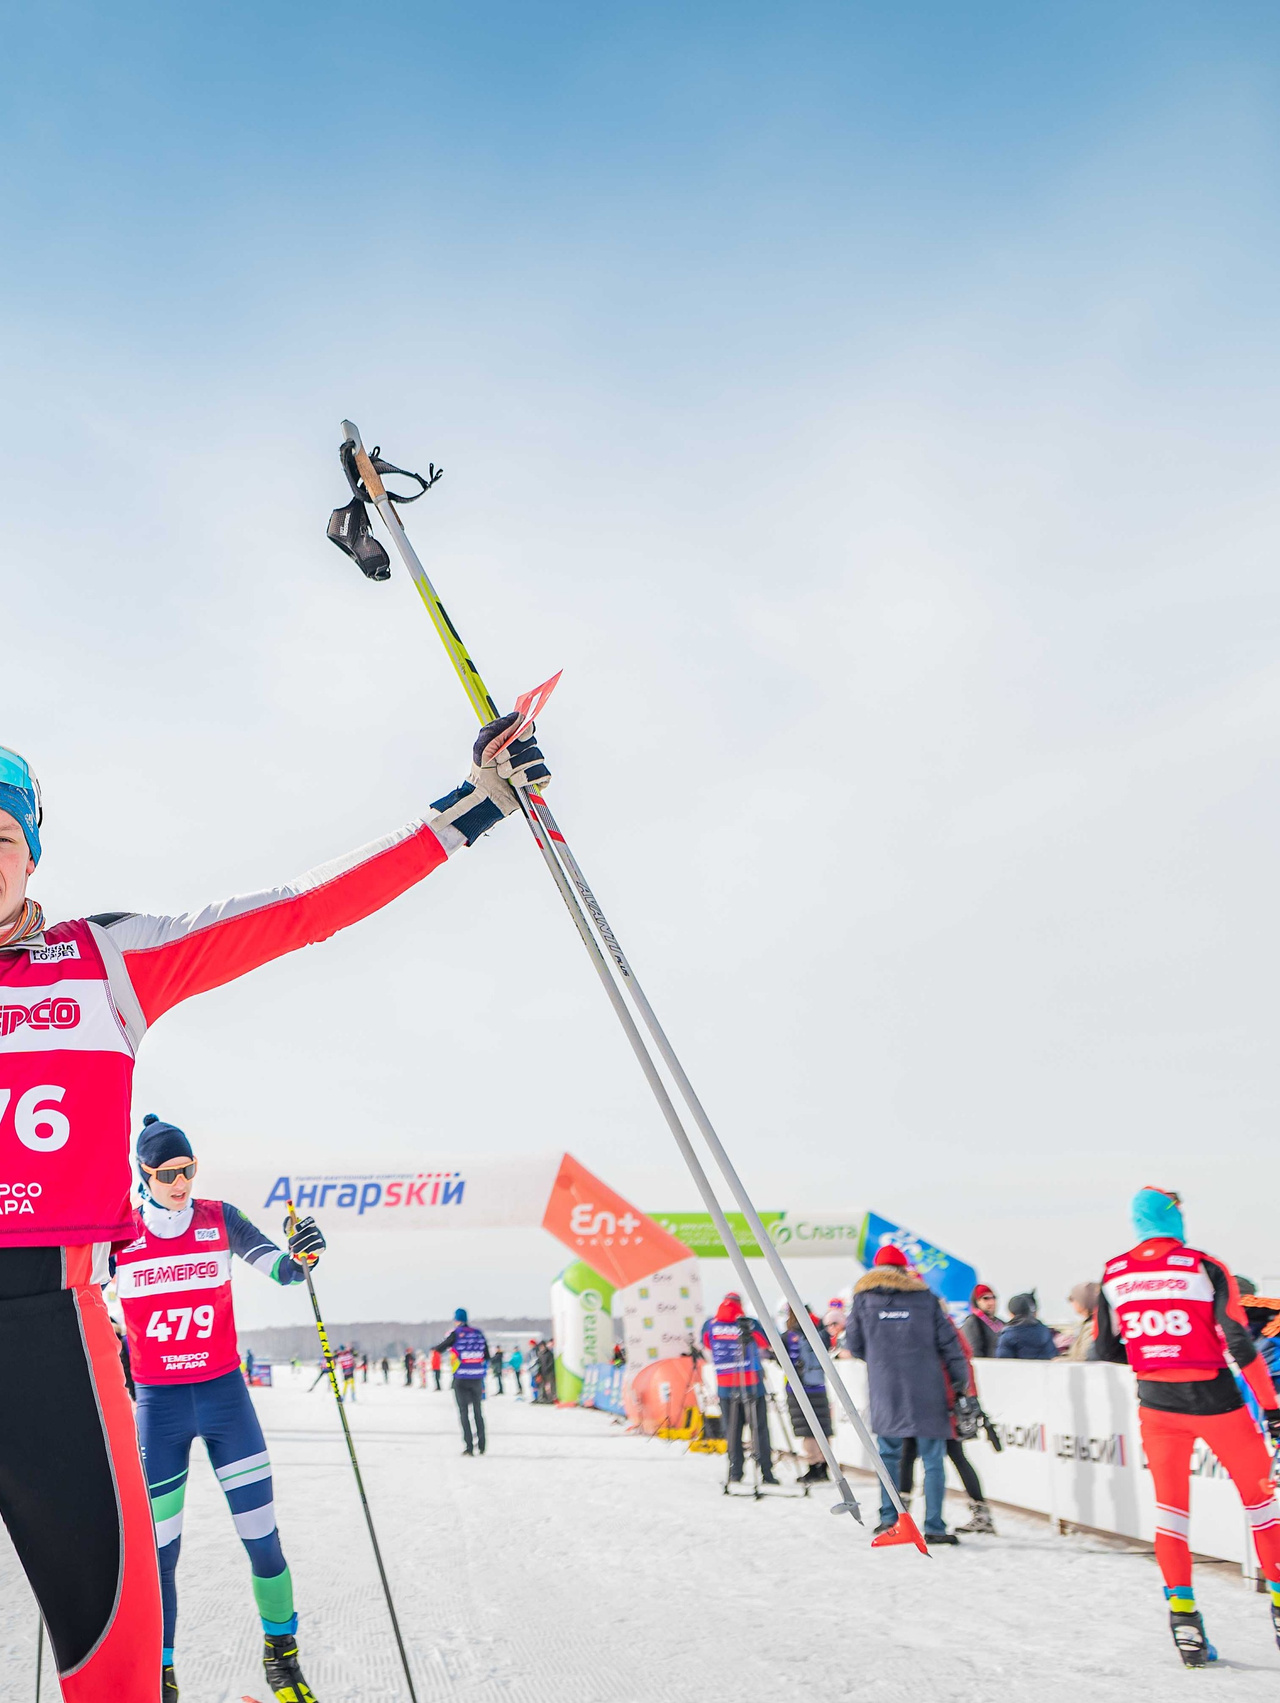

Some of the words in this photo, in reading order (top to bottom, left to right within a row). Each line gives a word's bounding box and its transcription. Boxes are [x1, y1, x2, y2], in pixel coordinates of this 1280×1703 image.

[576, 880, 624, 955] AVANTI
[614, 954, 630, 977] PLUS
[795, 1221, 858, 1241] Слата
[133, 1261, 219, 1288] ТЕМЕРСО
[146, 1305, 215, 1342] 479
[1121, 1309, 1192, 1339] 308
[160, 1351, 210, 1363] ТЕМЕРСО
[165, 1359, 207, 1371] АНГАРА
